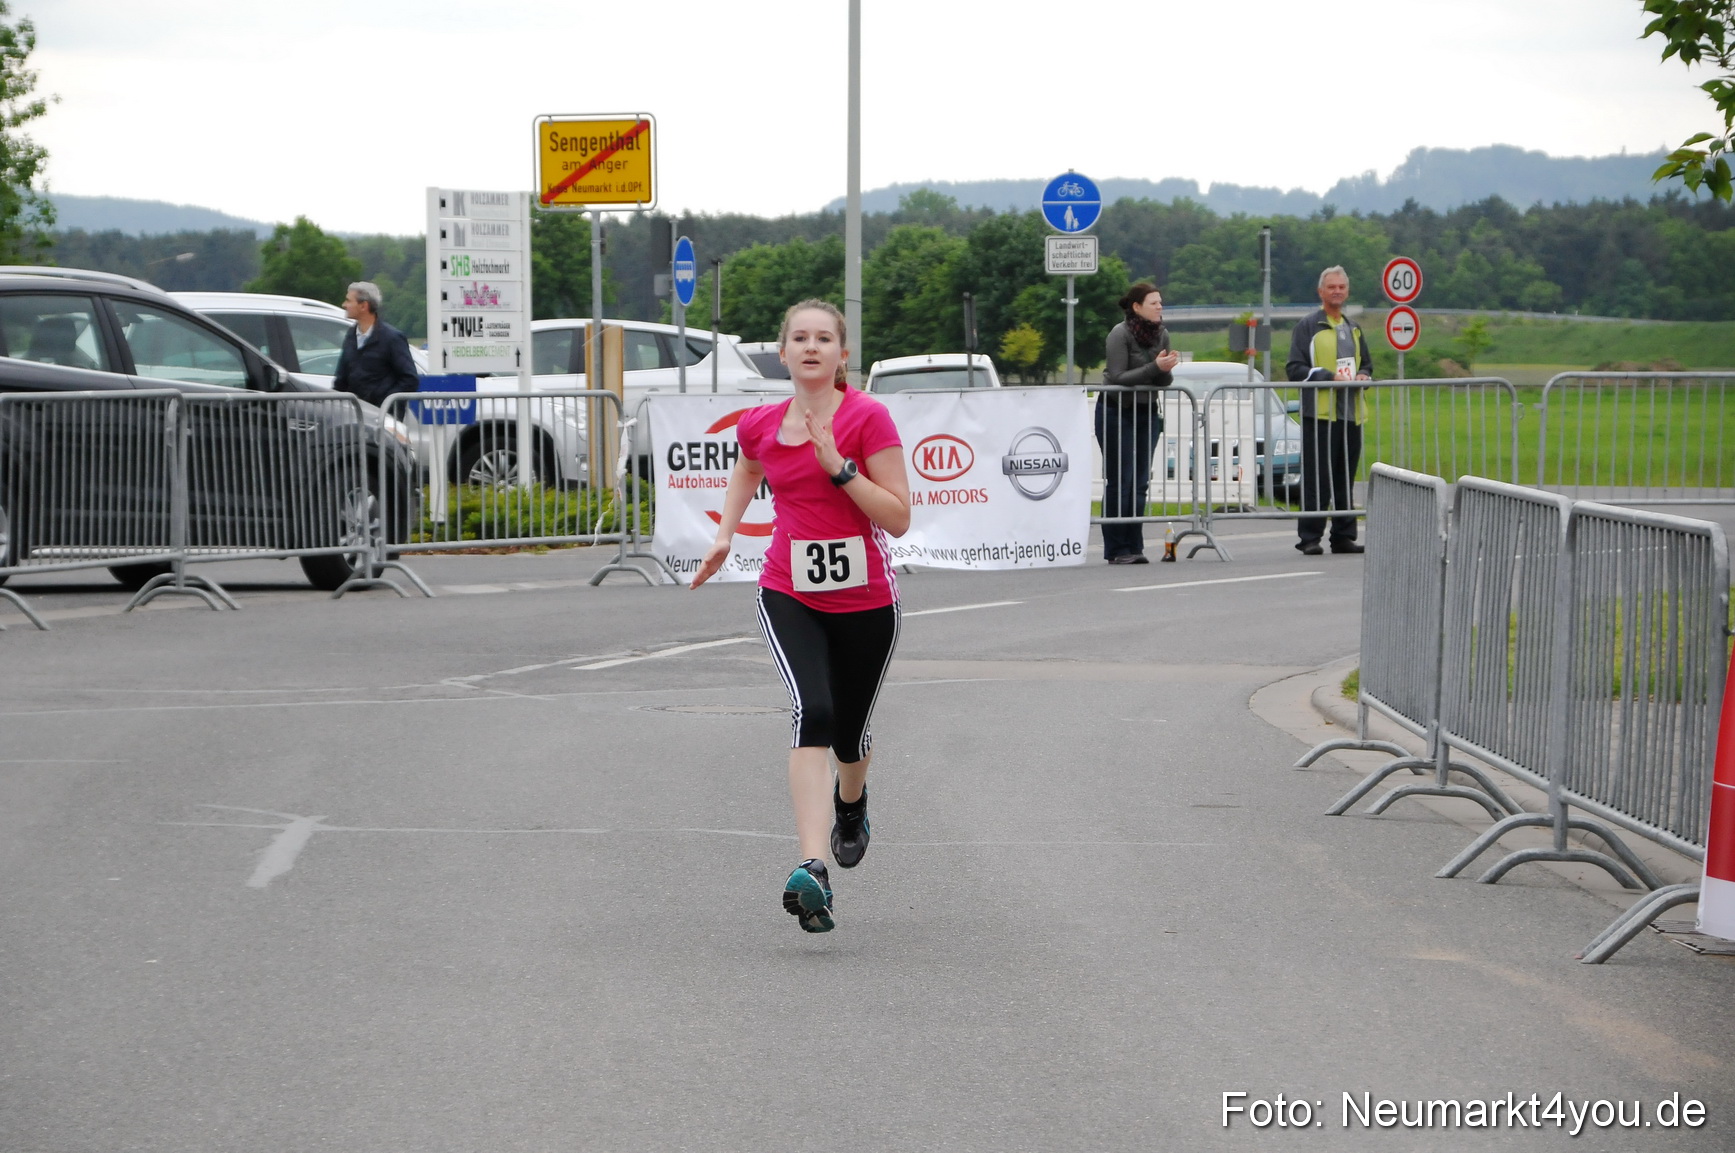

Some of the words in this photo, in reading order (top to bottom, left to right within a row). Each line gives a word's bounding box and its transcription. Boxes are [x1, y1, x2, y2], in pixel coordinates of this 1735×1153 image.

[549, 130, 641, 157] Sengenthal
[561, 160, 581, 171] am
[588, 158, 628, 173] Anger
[571, 181, 612, 193] Neumarkt
[1055, 241, 1088, 250] Landwirt-
[1051, 251, 1092, 259] schaftlicher
[1051, 260, 1078, 268] Verkehr
[1080, 260, 1093, 268] frei
[450, 255, 471, 277] SHB
[1392, 271, 1413, 290] 60
[451, 316, 484, 338] THULE
[922, 446, 963, 471] KIA
[1009, 457, 1062, 471] NISSAN
[667, 473, 728, 489] Autohaus
[909, 491, 924, 506] IA
[928, 488, 989, 506] MOTORS
[928, 538, 1082, 565] www.gerhart-jaenig.de
[806, 541, 851, 585] 35
